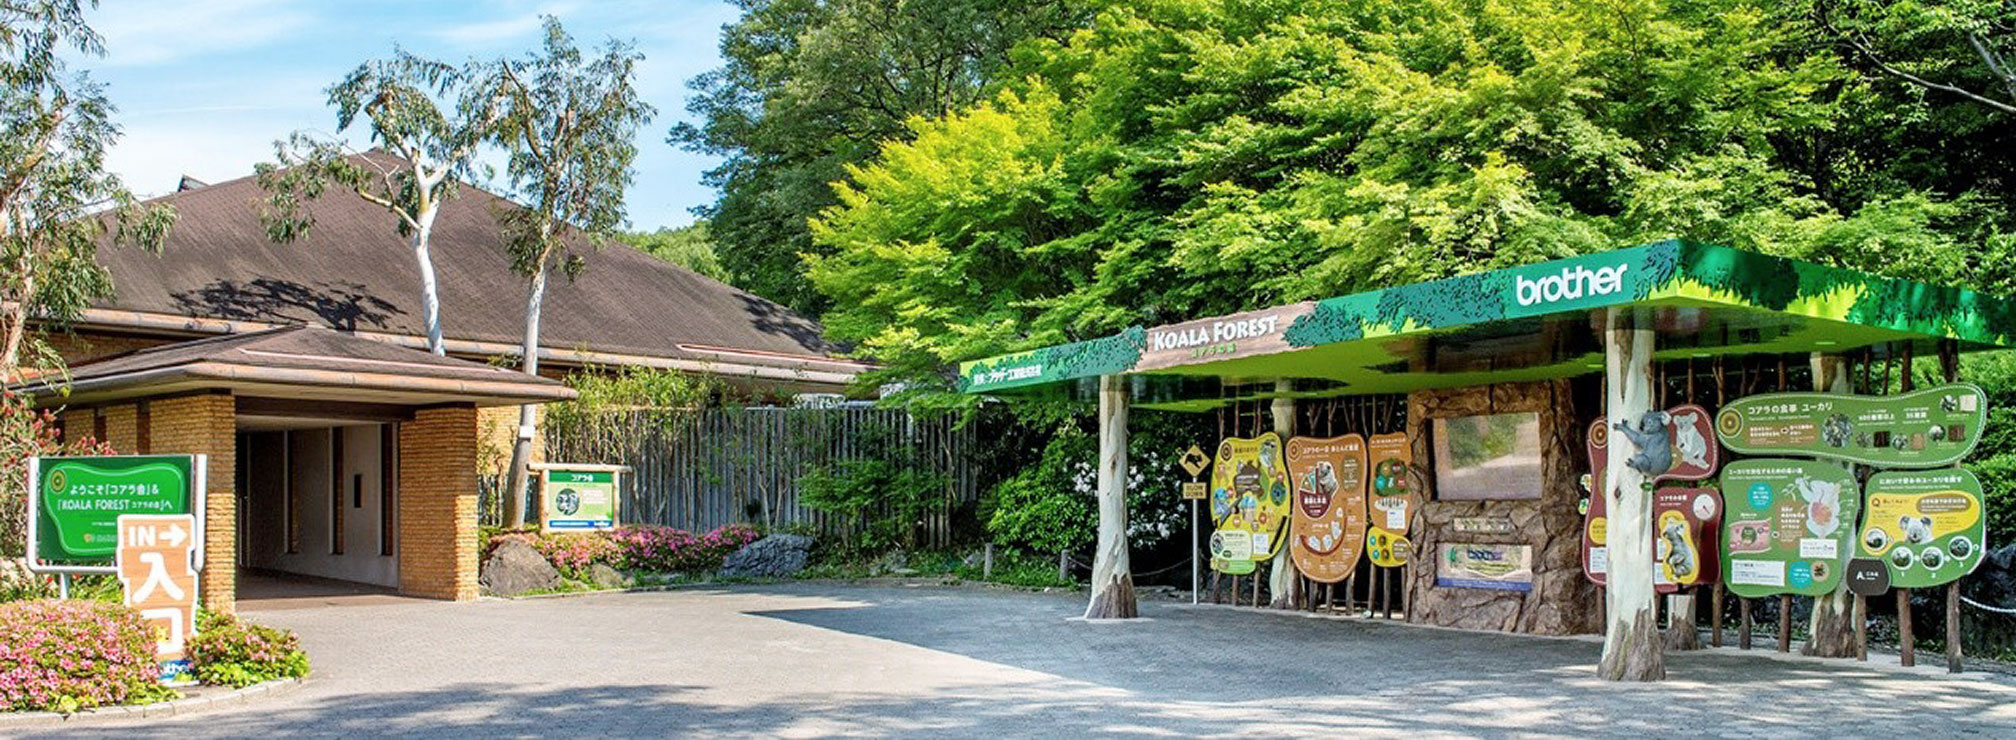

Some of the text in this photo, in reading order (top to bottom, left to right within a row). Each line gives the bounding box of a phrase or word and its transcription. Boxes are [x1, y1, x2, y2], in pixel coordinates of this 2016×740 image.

[1516, 263, 1628, 306] brother
[1154, 315, 1278, 351] KOALA FOREST
[1801, 402, 1833, 412] ユーカリ
[95, 499, 130, 510] FOREST
[128, 525, 156, 547] IN
